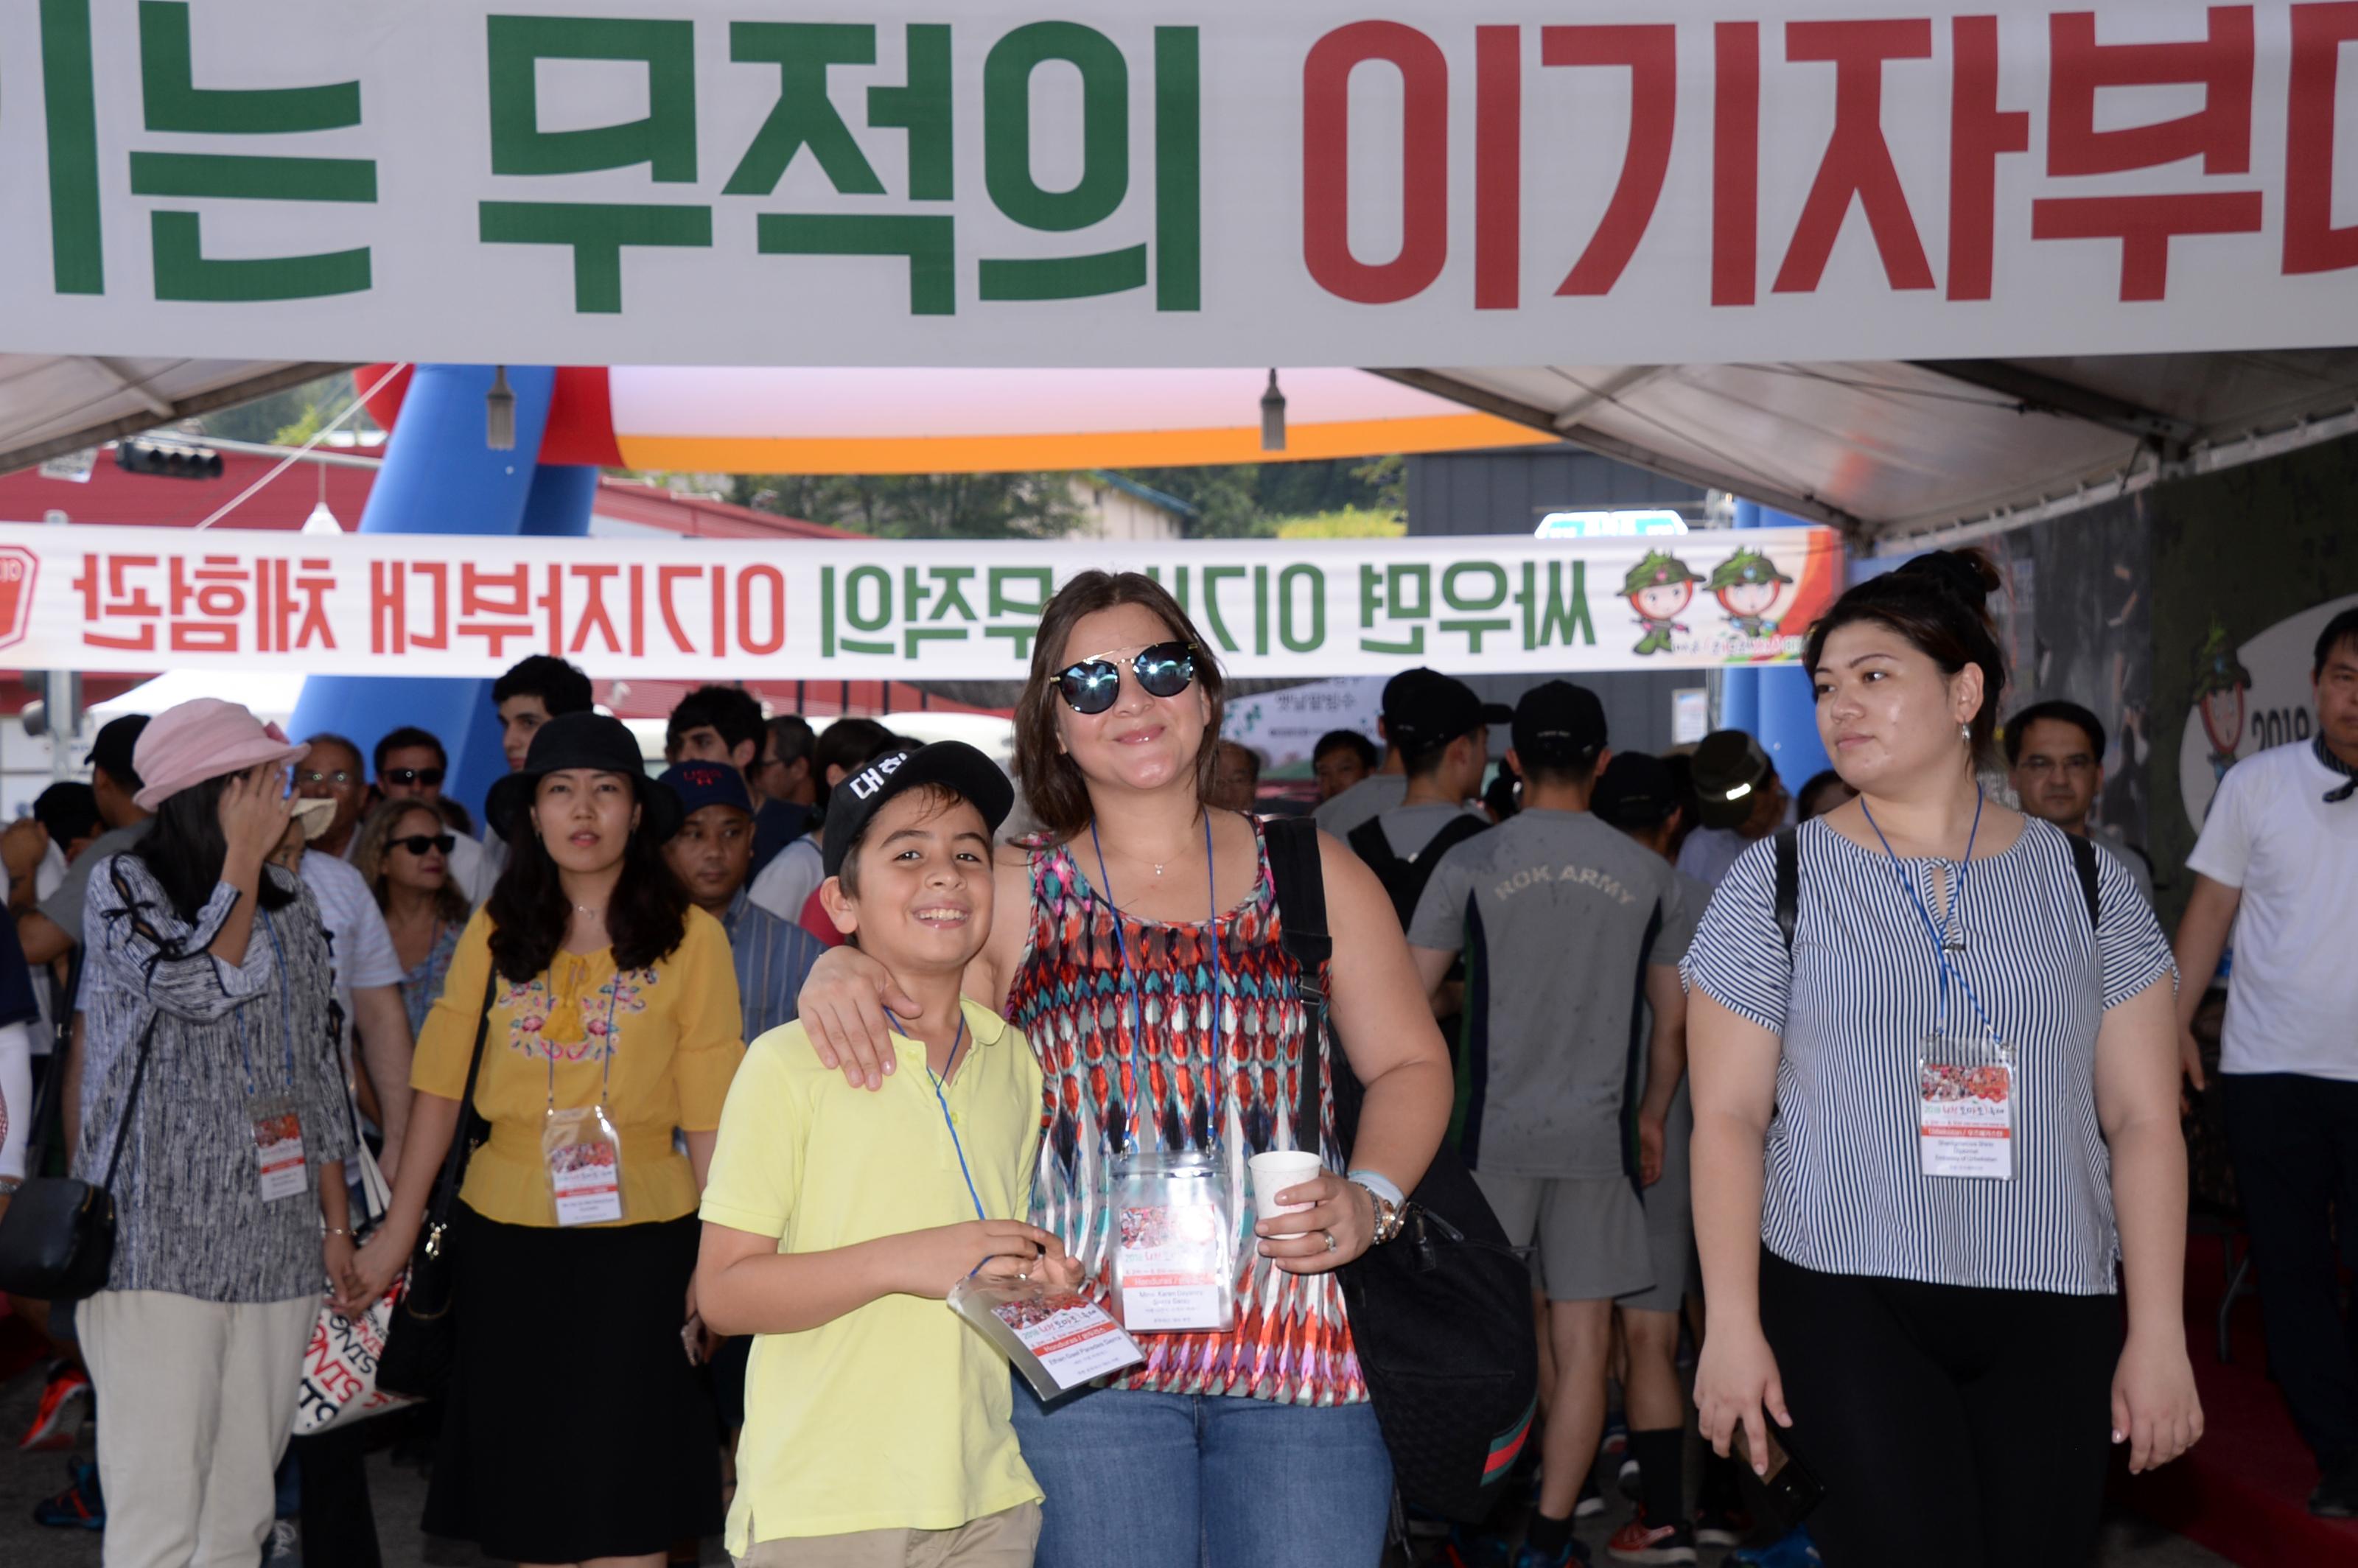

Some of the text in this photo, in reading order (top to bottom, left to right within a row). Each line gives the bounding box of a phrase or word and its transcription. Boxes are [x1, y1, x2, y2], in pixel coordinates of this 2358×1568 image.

[477, 14, 1202, 315] 무적의
[1494, 864, 1637, 904] ROK ARMY
[1043, 1337, 1077, 1352] Honduras
